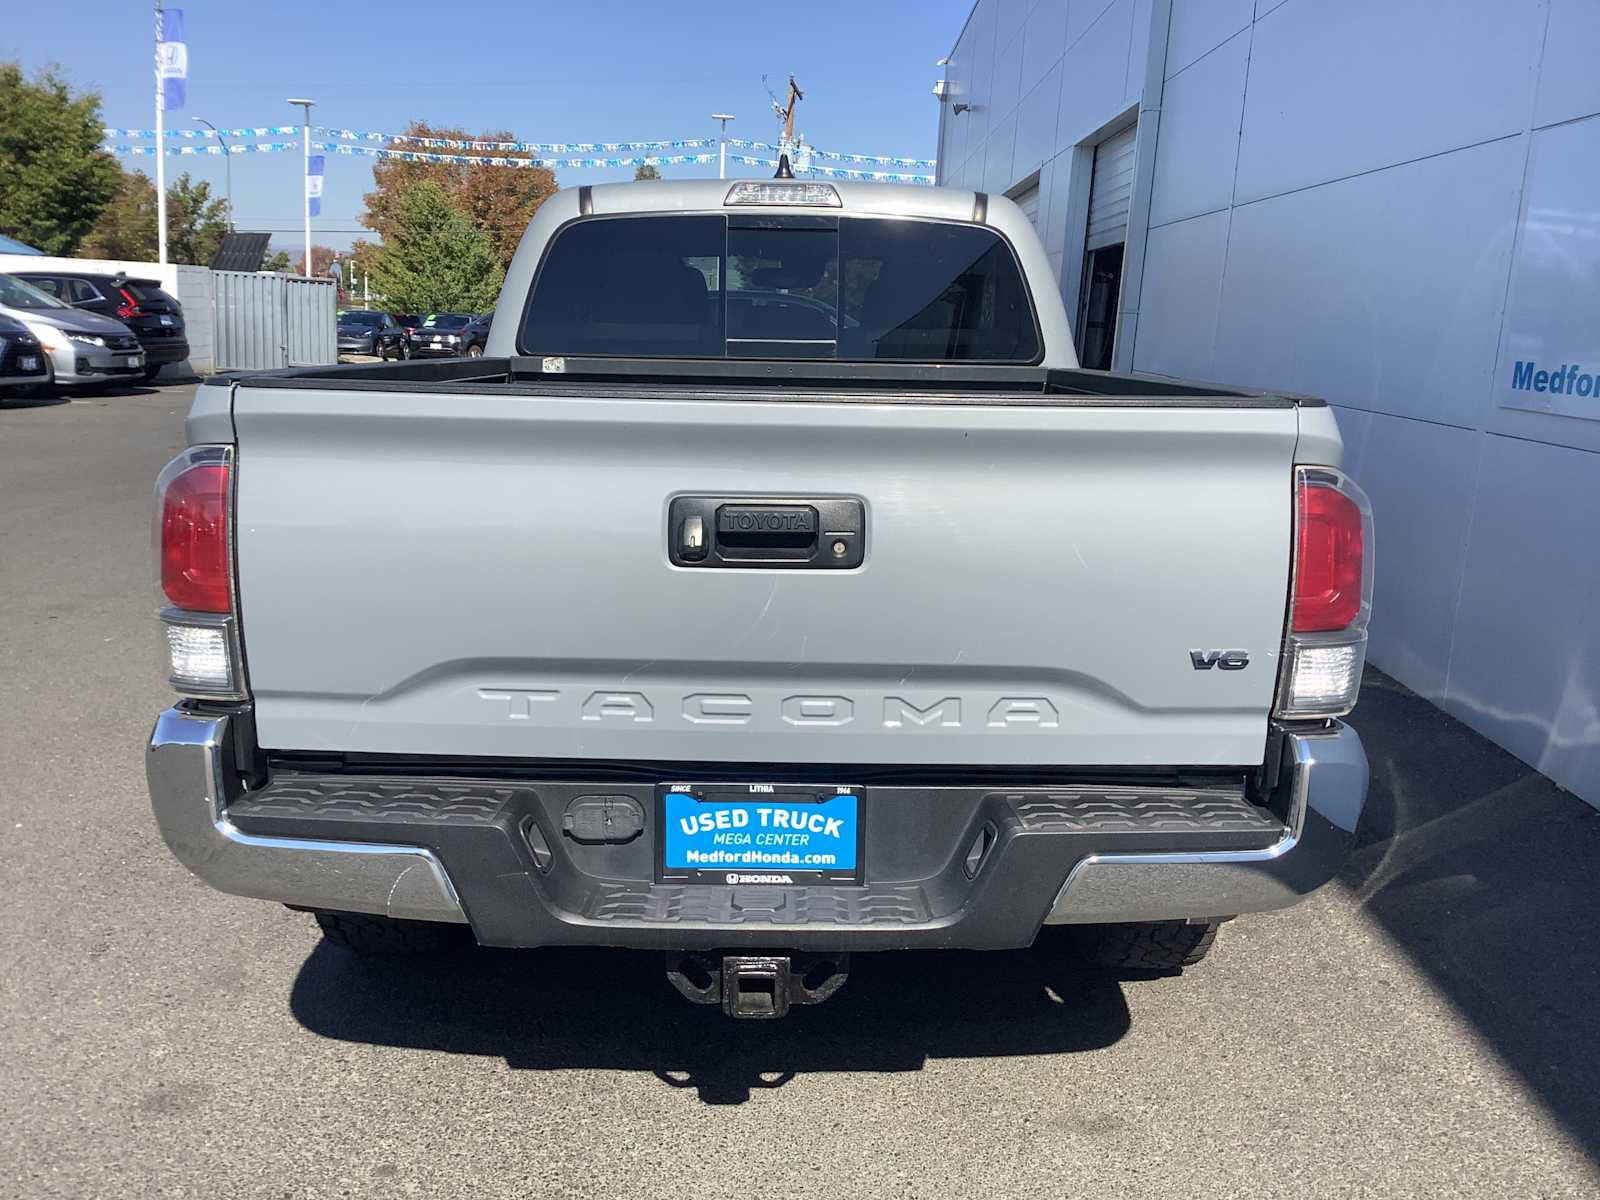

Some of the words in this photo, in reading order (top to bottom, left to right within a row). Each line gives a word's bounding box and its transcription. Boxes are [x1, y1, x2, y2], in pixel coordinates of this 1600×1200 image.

[725, 512, 810, 530] TOYOTA
[1189, 648, 1249, 670] V6
[478, 688, 1059, 727] TACOMA
[749, 785, 775, 793] LITHIA
[680, 809, 748, 835] USED
[756, 808, 844, 838] TRUCK
[713, 833, 751, 845] MEGA
[756, 833, 809, 846] CENTER
[687, 850, 836, 864] MedfordHonda.com
[738, 874, 793, 884] HONDA
